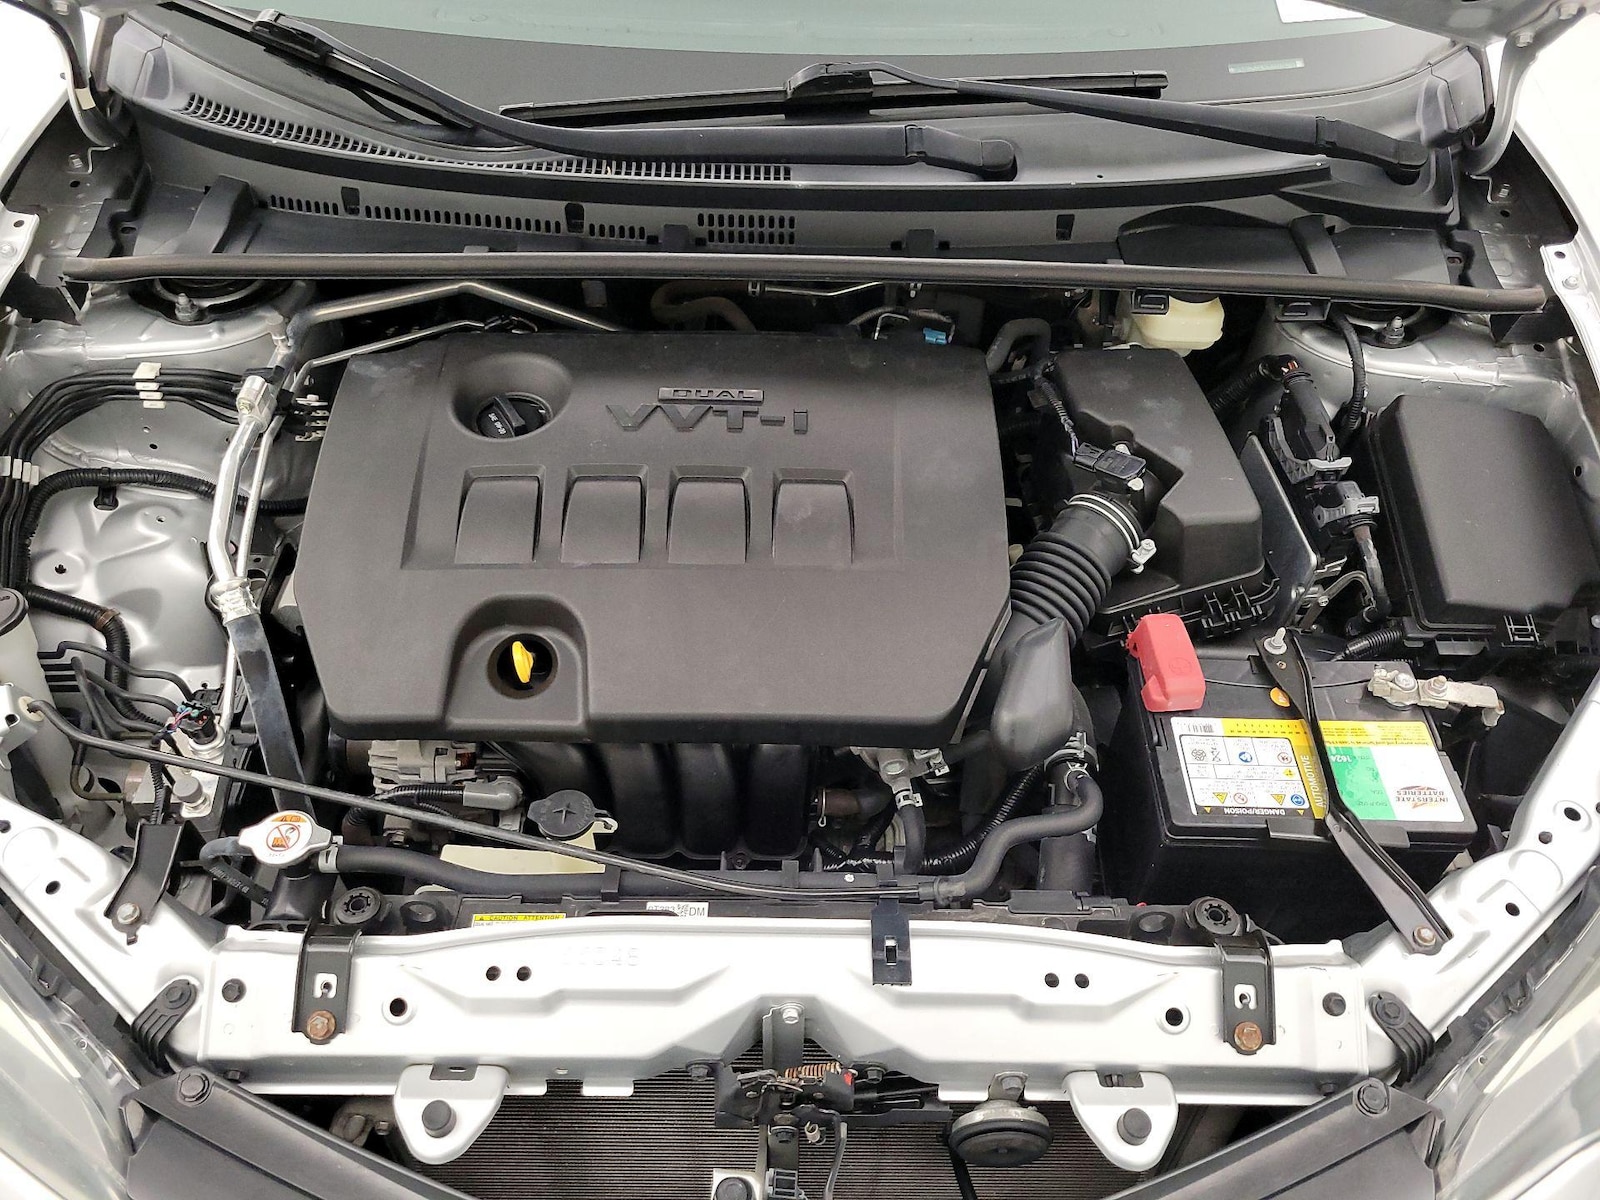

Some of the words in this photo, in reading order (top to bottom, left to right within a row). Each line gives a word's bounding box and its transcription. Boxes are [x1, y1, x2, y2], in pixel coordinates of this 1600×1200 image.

[672, 389, 754, 399] DUAL
[605, 403, 809, 434] VVT-i
[1300, 754, 1325, 808] AUTOMOTIVE
[1223, 807, 1286, 816] DANGER/POISON
[688, 906, 705, 917] DM
[523, 913, 561, 921] ATTENTION
